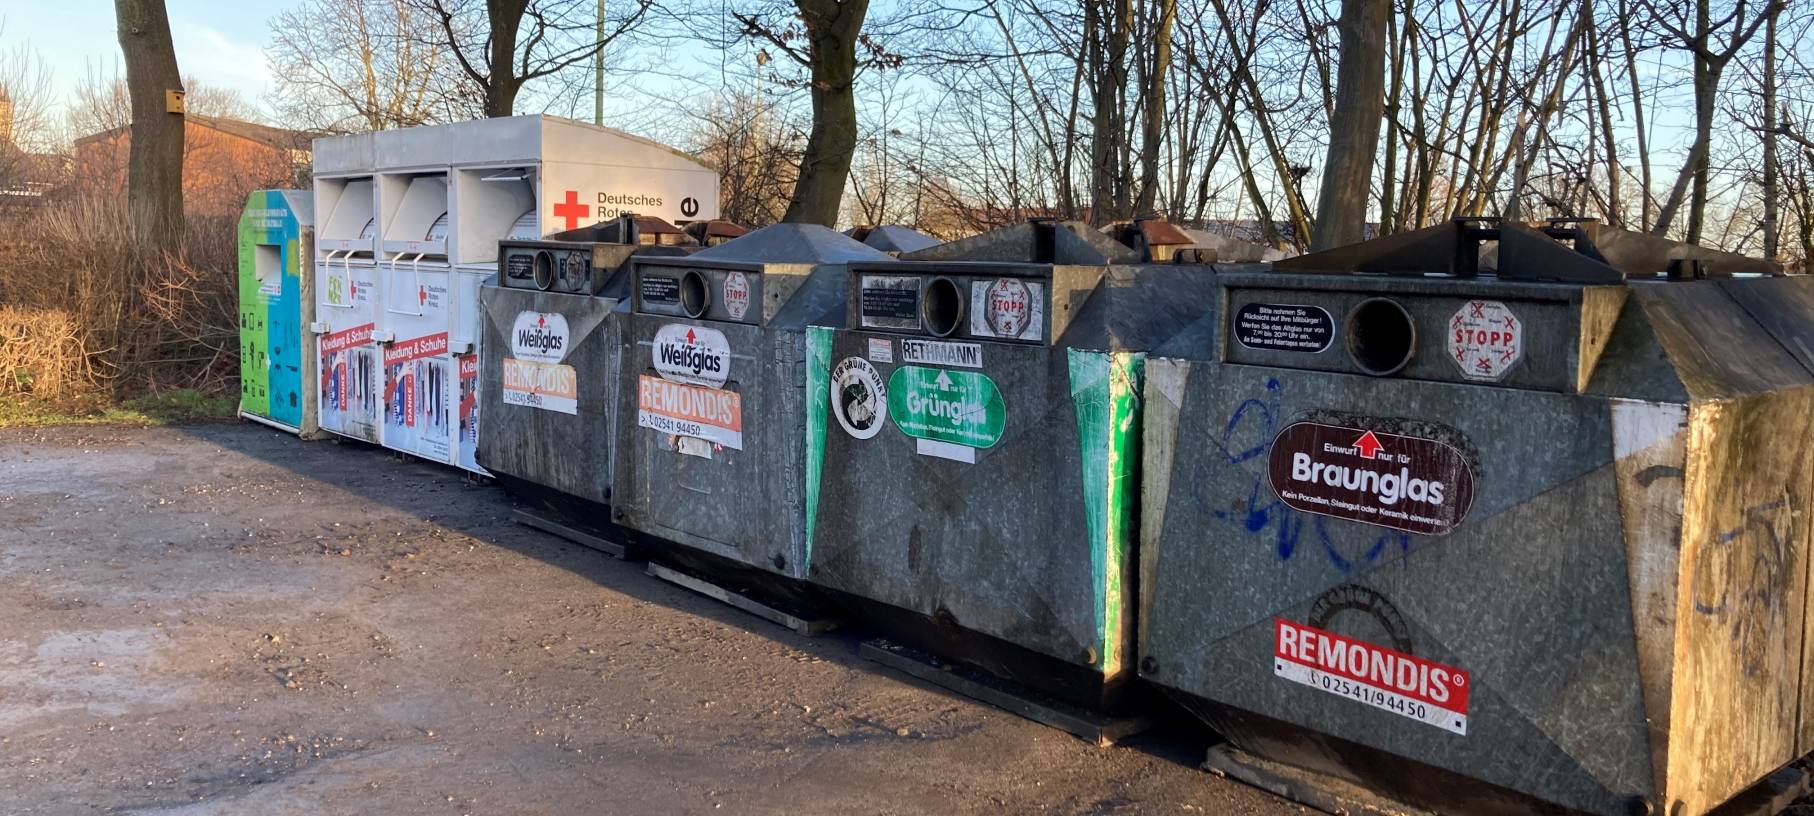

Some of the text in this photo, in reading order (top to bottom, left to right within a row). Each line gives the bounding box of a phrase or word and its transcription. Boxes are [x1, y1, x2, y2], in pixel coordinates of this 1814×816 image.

[598, 191, 663, 206] Deutsches
[726, 290, 746, 300] STOPP
[992, 300, 1024, 312] STOPP
[322, 336, 345, 351] Kleidung
[346, 332, 351, 344] &
[519, 329, 562, 354] Weißglas
[1456, 329, 1513, 346] STOPP
[385, 338, 446, 361] Kleidung & Schuhe
[660, 342, 720, 374] Weißglas
[461, 359, 476, 374] Klei
[832, 366, 844, 383] DER
[844, 358, 867, 371] GRÜNE
[654, 416, 700, 436] 02541 94450
[1324, 443, 1410, 464] Einwurf nur für
[1292, 452, 1444, 505] Braunglas
[1282, 490, 1297, 499] Kein
[1298, 493, 1329, 506] Porzellan,
[1331, 498, 1360, 510] Steingut
[1361, 505, 1377, 514] oder
[1379, 508, 1409, 519] Keramik
[1322, 675, 1426, 718] 02541/94450
